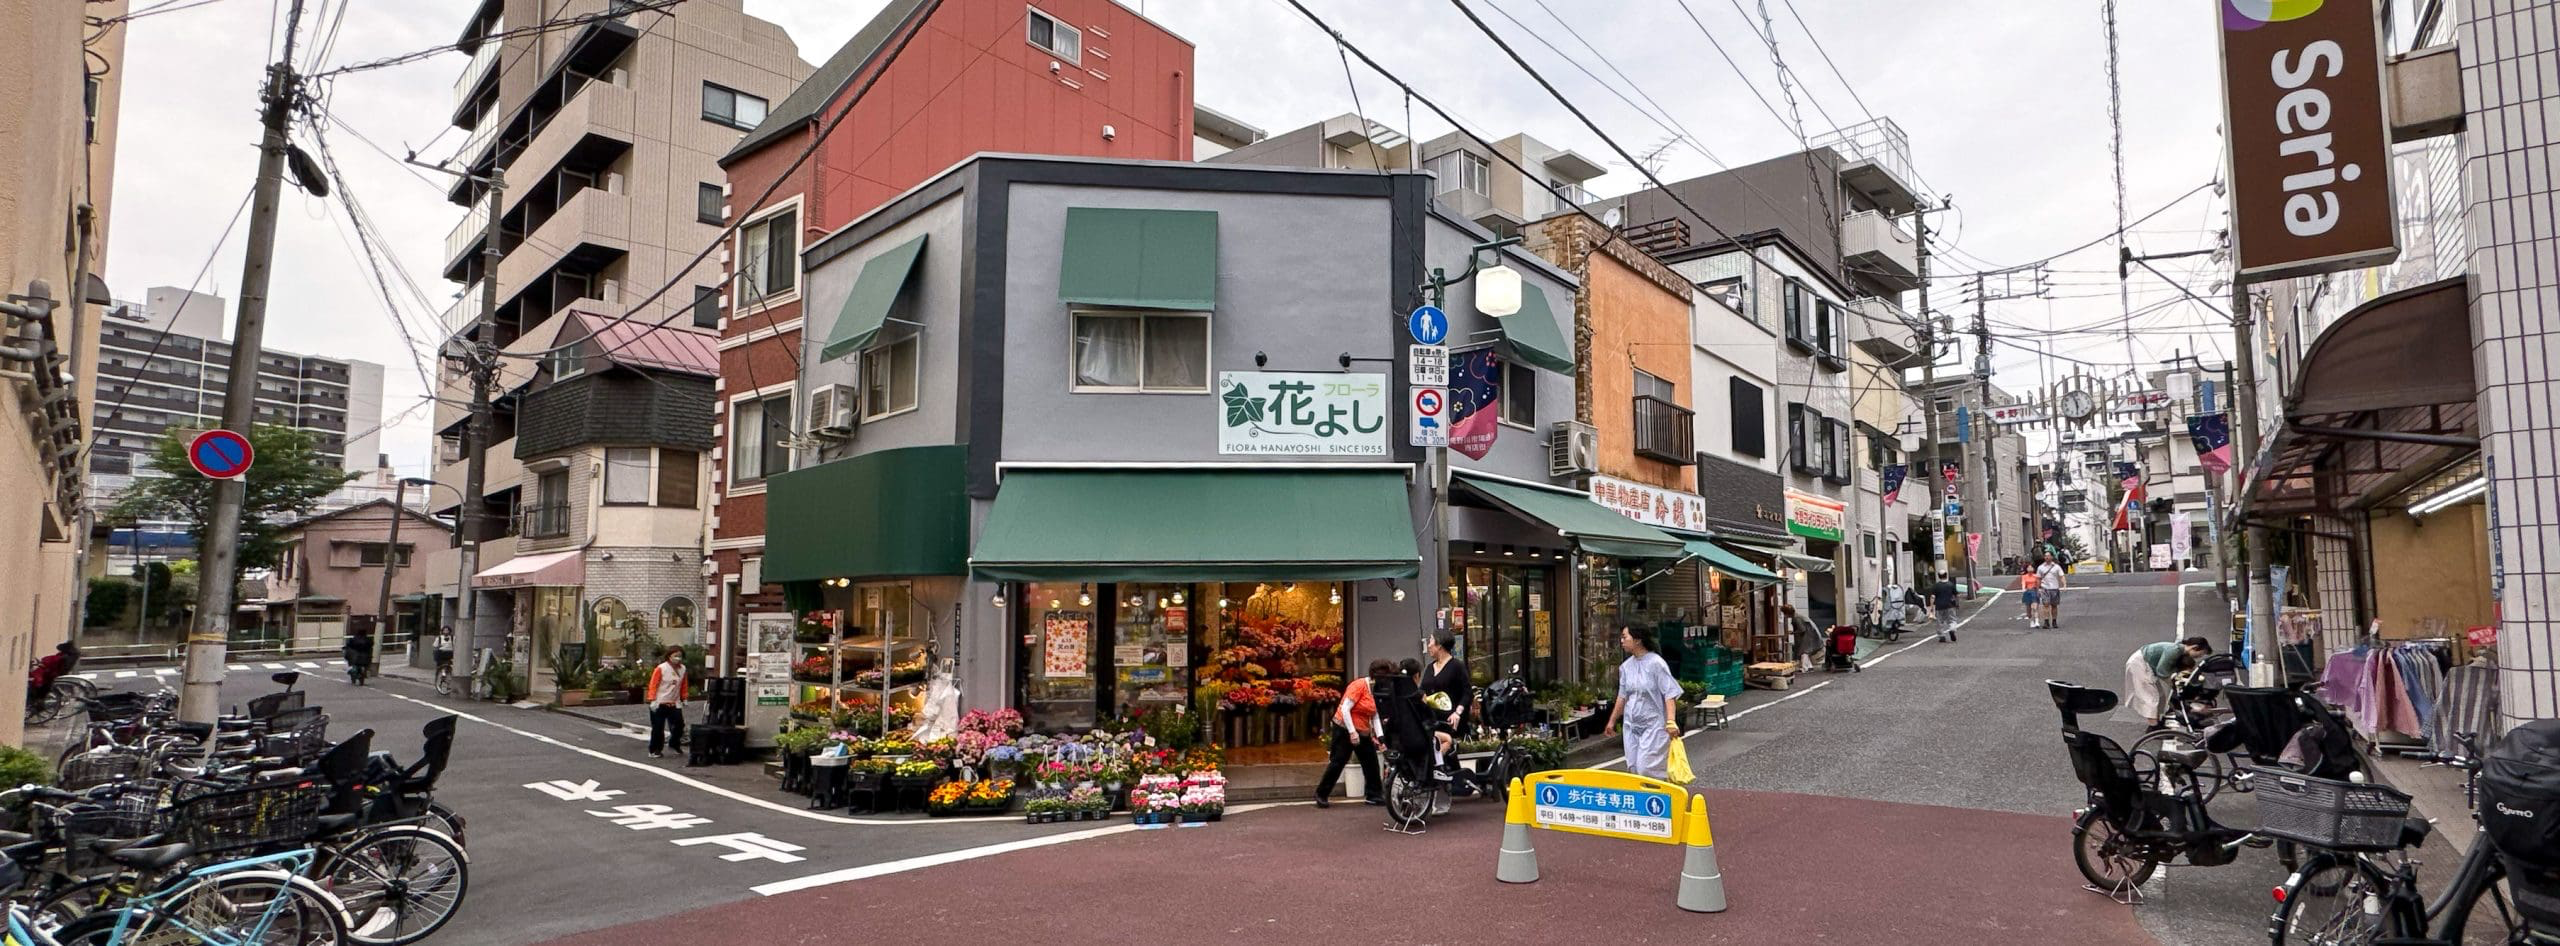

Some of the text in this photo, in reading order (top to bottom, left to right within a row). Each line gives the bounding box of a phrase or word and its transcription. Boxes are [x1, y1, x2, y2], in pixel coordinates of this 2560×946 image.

[2271, 39, 2361, 237] Seria
[1324, 383, 1380, 397] フローラ
[1268, 380, 1384, 438] 花よし
[1226, 443, 1382, 453] FLORA HANAYOSHI SINCE 1955
[1594, 479, 1650, 512] 中華物産店
[1567, 789, 1635, 809] 歩行者専用
[1540, 810, 1554, 819] 平日
